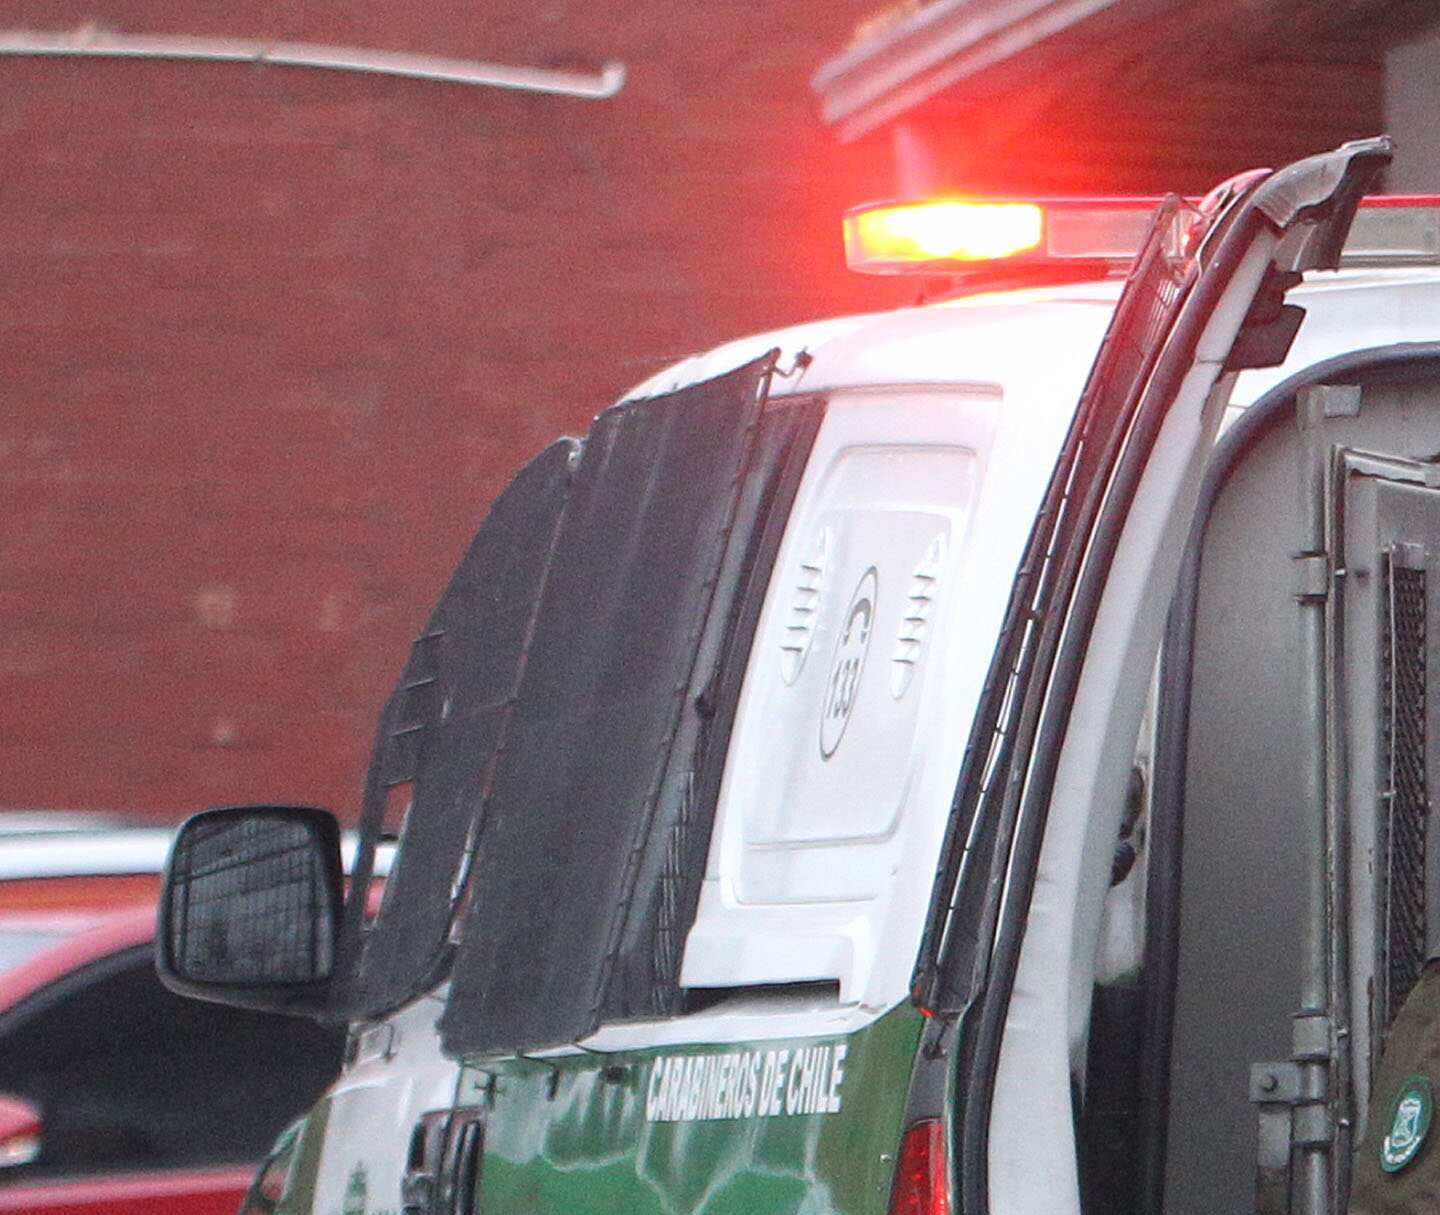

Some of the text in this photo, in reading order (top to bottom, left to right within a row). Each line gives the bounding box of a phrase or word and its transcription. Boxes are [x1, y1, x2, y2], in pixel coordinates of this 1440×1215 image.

[646, 1044, 848, 1122] CARABINEROS DE CHILE
